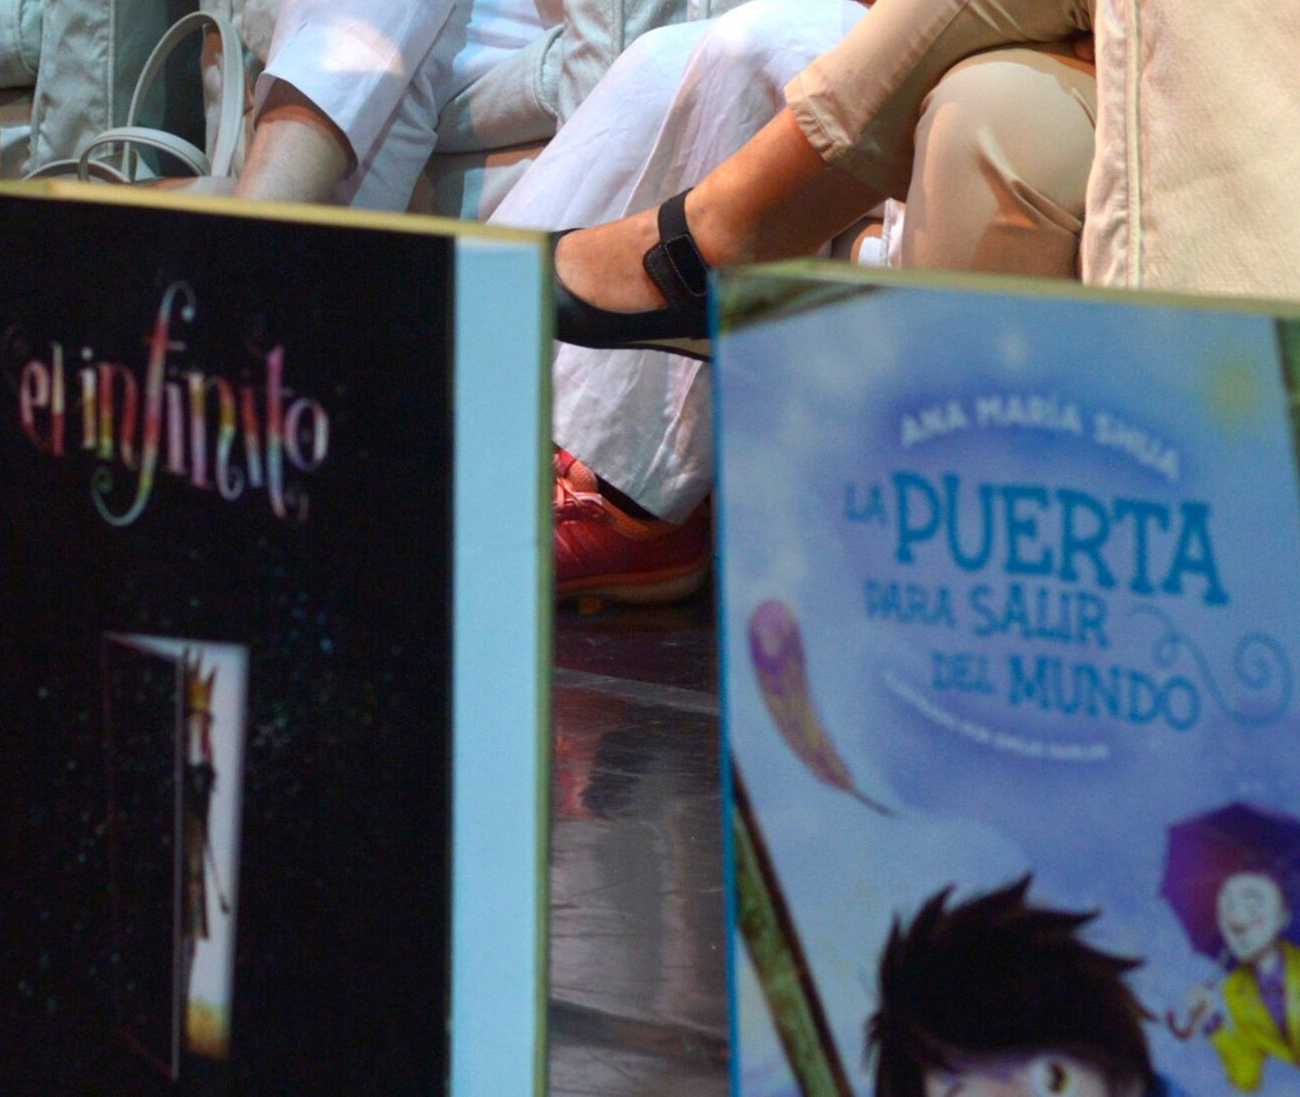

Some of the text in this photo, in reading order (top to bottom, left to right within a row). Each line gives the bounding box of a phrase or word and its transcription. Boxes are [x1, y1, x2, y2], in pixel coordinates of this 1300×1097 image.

[18, 279, 330, 527] el infinito
[902, 392, 1181, 483] ANA MARÍA SHUA
[843, 468, 1231, 608] LA PUERTA
[863, 579, 1111, 649] PARA SALIR
[931, 652, 994, 694] DEL
[1008, 653, 1201, 732] MUNDO
